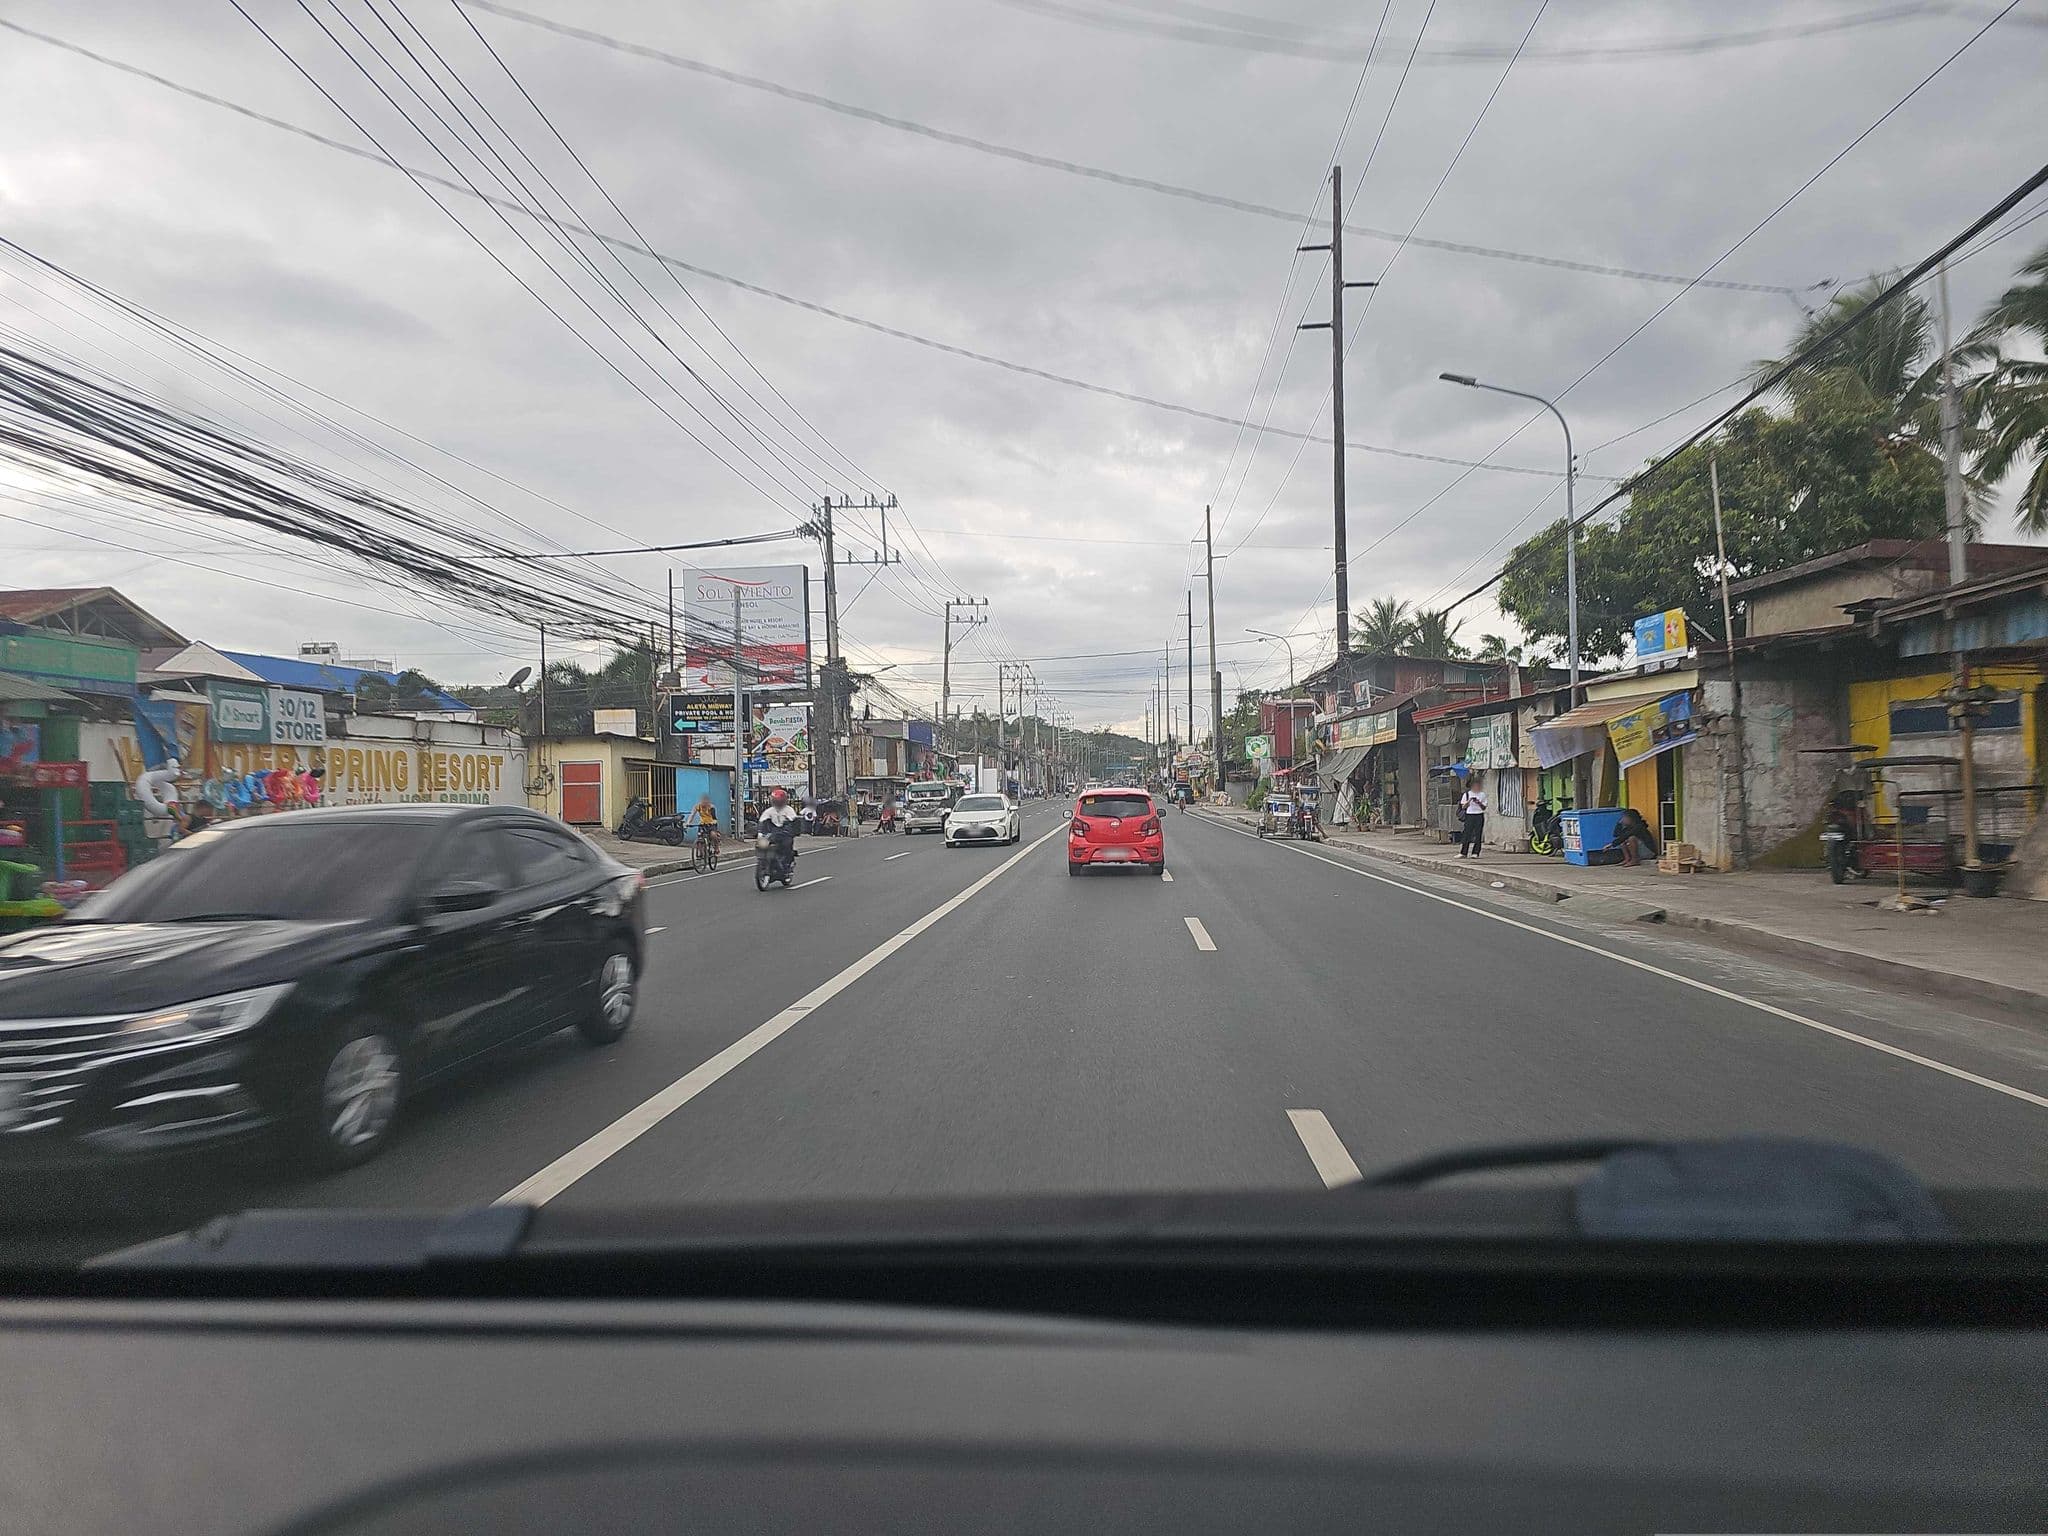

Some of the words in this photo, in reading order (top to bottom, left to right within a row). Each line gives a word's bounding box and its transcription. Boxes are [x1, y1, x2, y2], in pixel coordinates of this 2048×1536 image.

[697, 585, 723, 600] SOL
[740, 585, 792, 599] VIENTO
[731, 601, 759, 609] PNSOL
[275, 721, 323, 741] STORE
[309, 746, 408, 793] SPRING
[417, 751, 504, 793] RESORT
